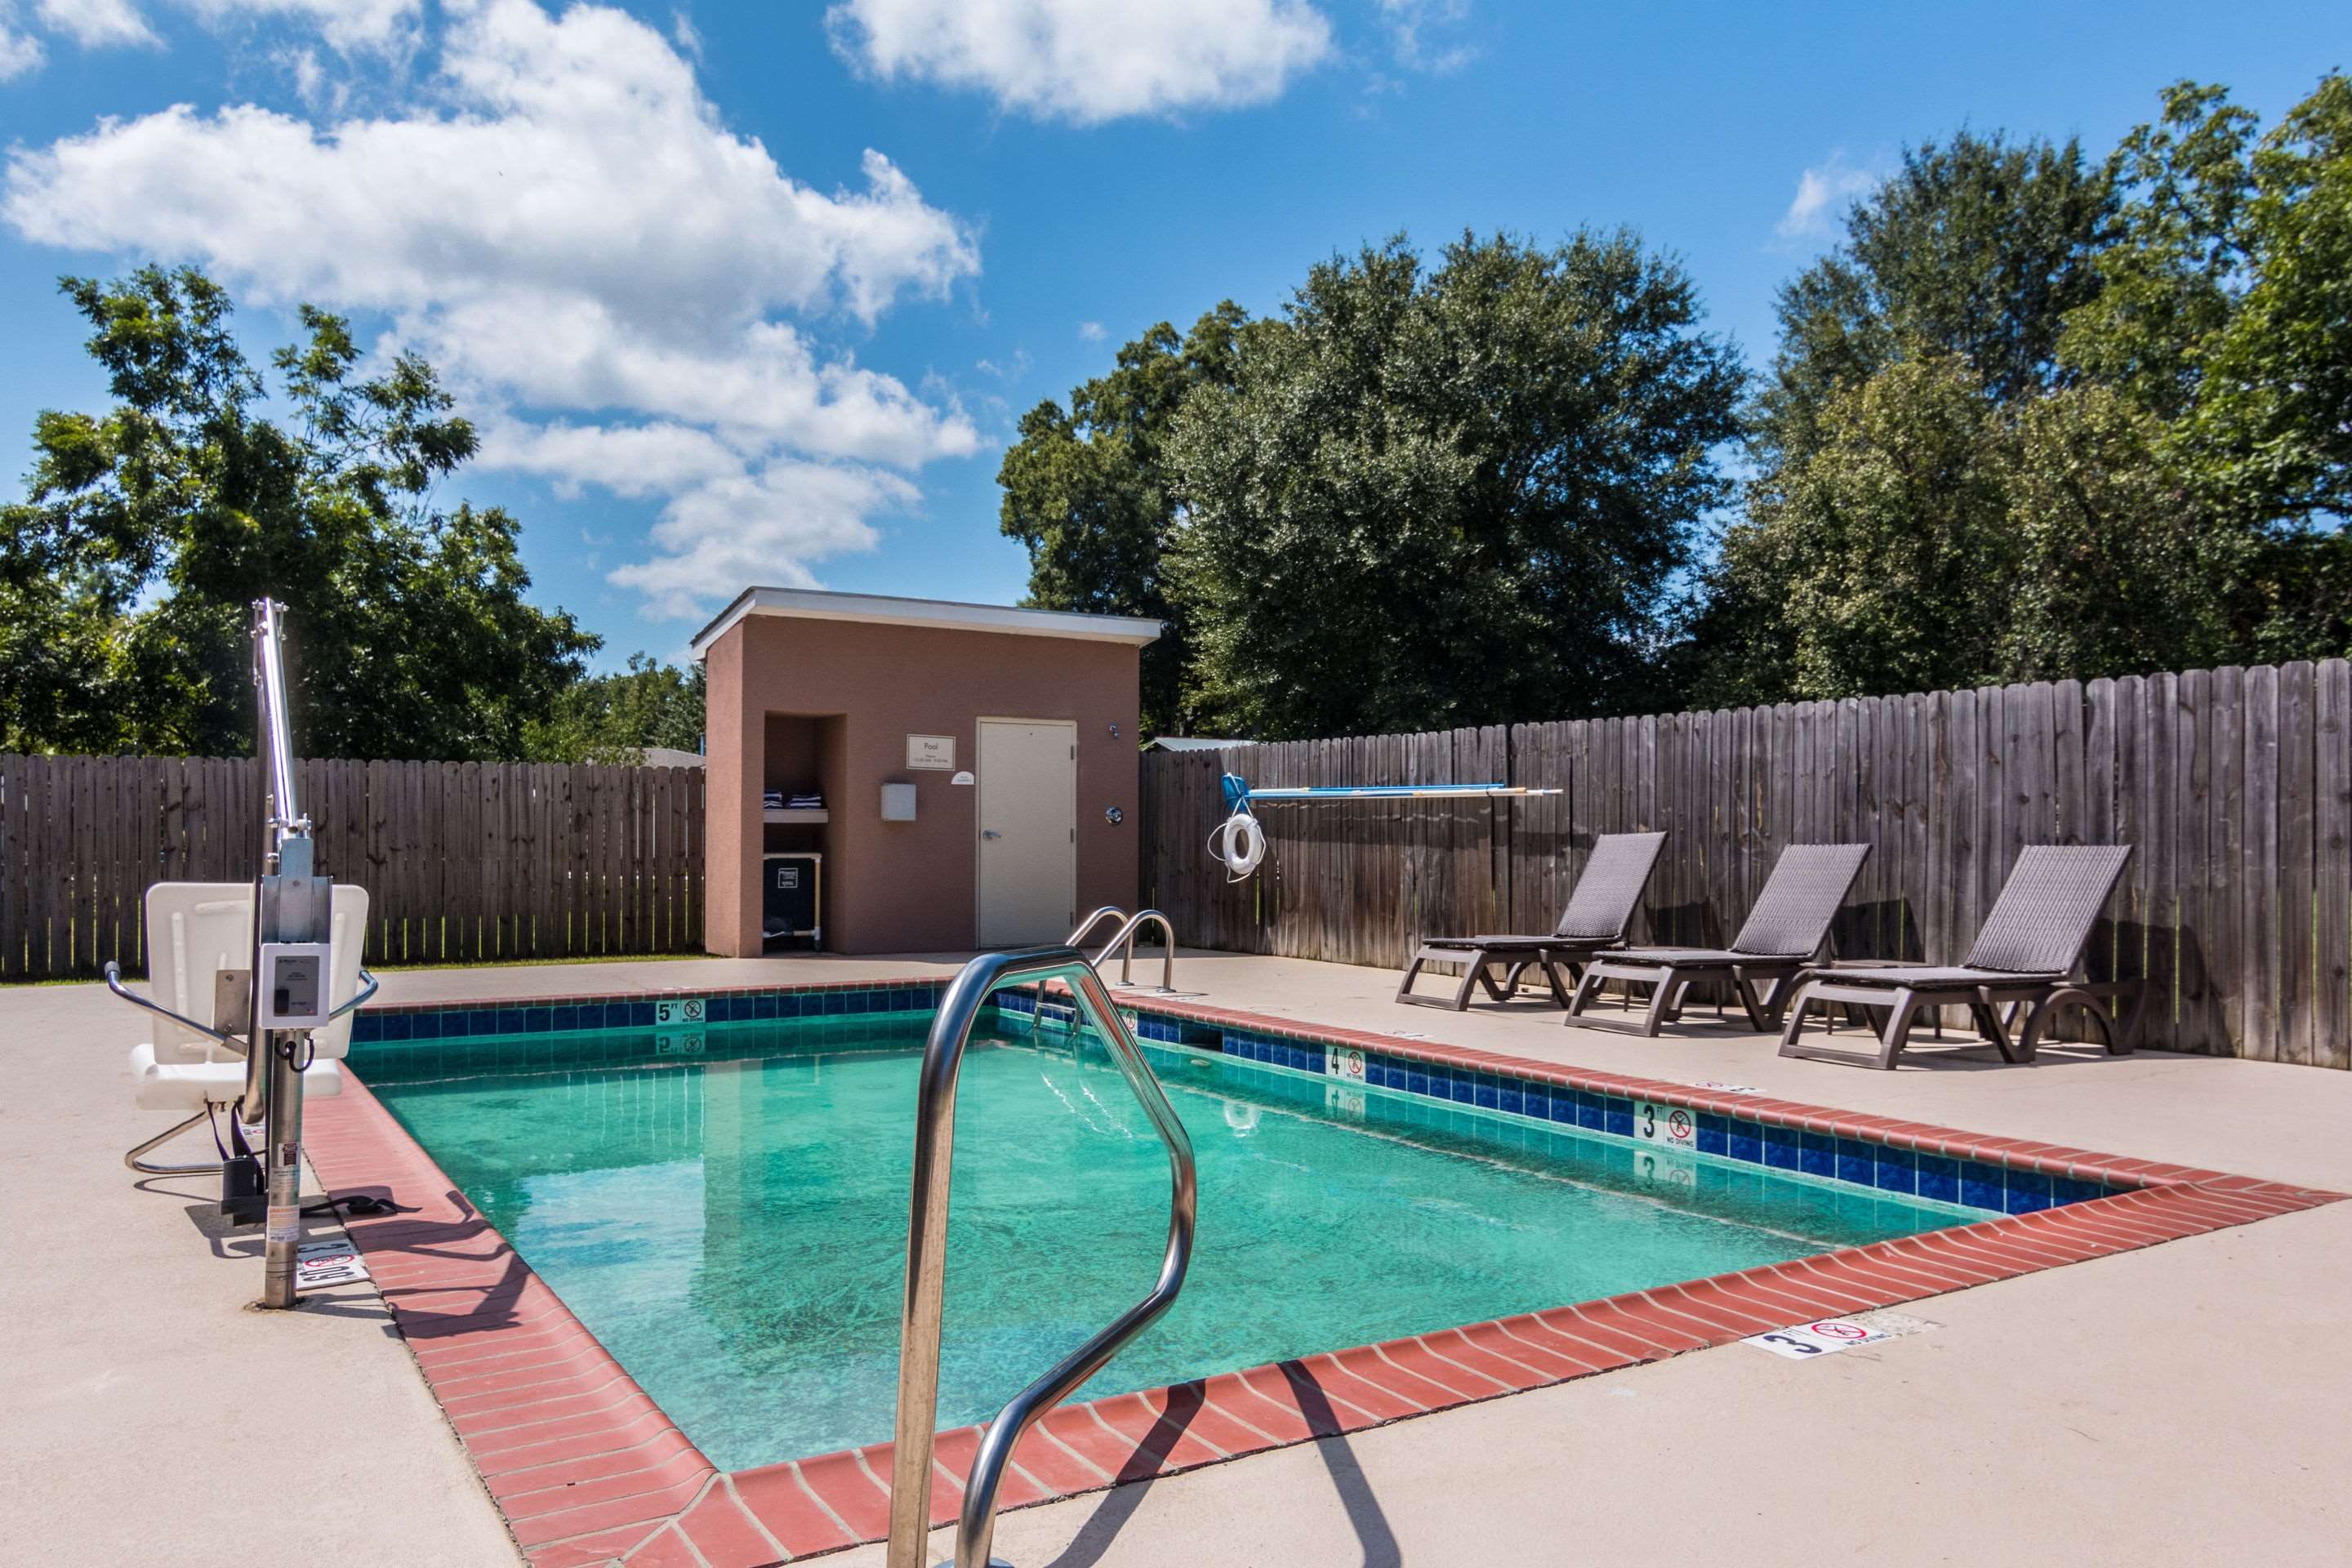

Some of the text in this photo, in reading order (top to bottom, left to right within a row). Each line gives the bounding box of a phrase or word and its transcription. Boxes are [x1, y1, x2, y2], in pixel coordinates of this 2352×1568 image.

[658, 1004, 670, 1022] 5
[1332, 1048, 1339, 1075] 4
[1643, 1105, 1664, 1138] 3 FT
[1762, 1334, 1822, 1354] 3
